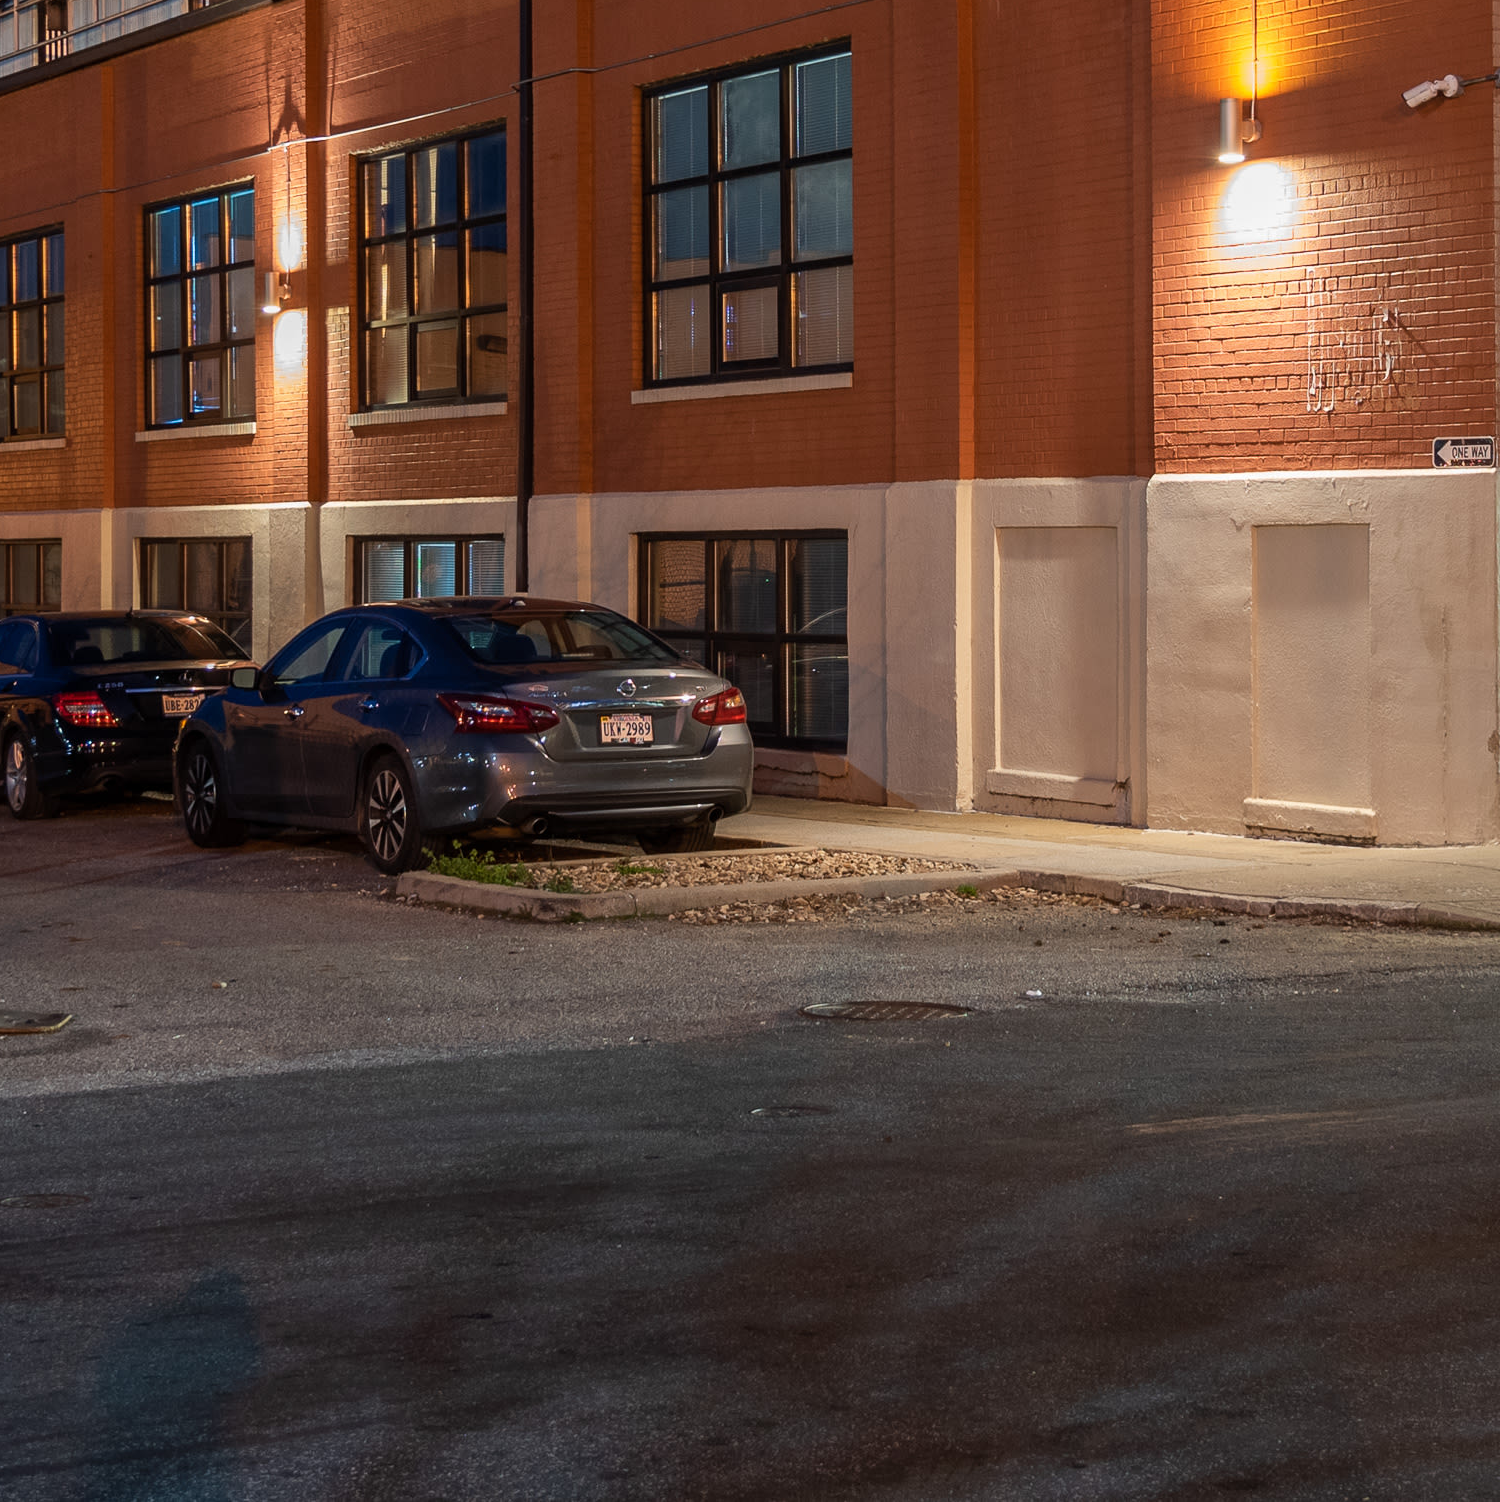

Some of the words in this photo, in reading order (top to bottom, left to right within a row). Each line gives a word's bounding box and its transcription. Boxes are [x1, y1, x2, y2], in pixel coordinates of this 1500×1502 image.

[1451, 446, 1469, 458] ONE
[1471, 445, 1489, 458] WAY
[165, 698, 200, 711] UBE-282
[603, 721, 651, 737] UKW-2989
